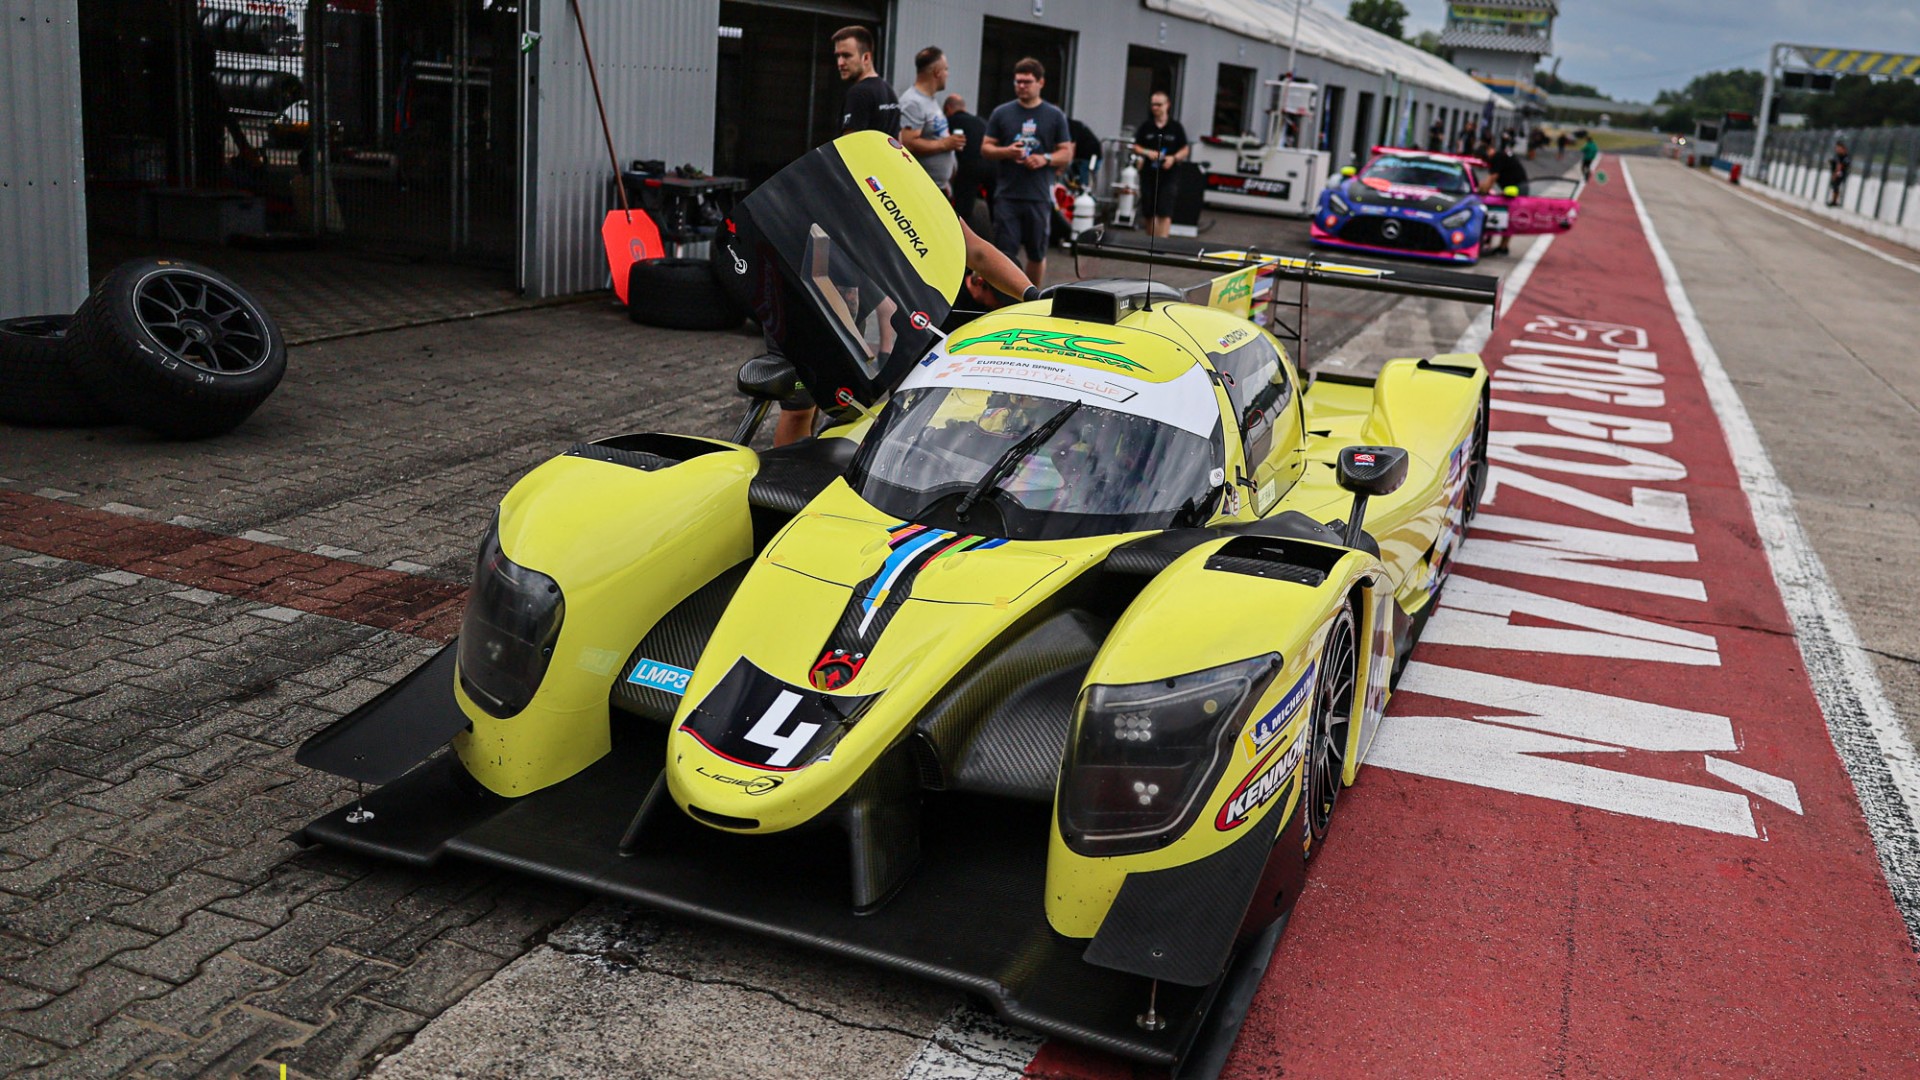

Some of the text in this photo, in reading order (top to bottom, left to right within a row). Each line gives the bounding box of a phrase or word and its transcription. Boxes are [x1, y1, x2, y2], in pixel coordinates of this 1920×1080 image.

[976, 360, 1066, 373] EUROPEAN SPRINT
[1000, 345, 1134, 372] BRATISLAVA
[1490, 339, 1665, 408] TOR
[969, 366, 1120, 396] PROTOTYPE CUP
[635, 663, 689, 689] LMP3
[1271, 674, 1312, 730] MICHELIN
[743, 689, 822, 767] 4
[1225, 733, 1304, 825] KENNOL
